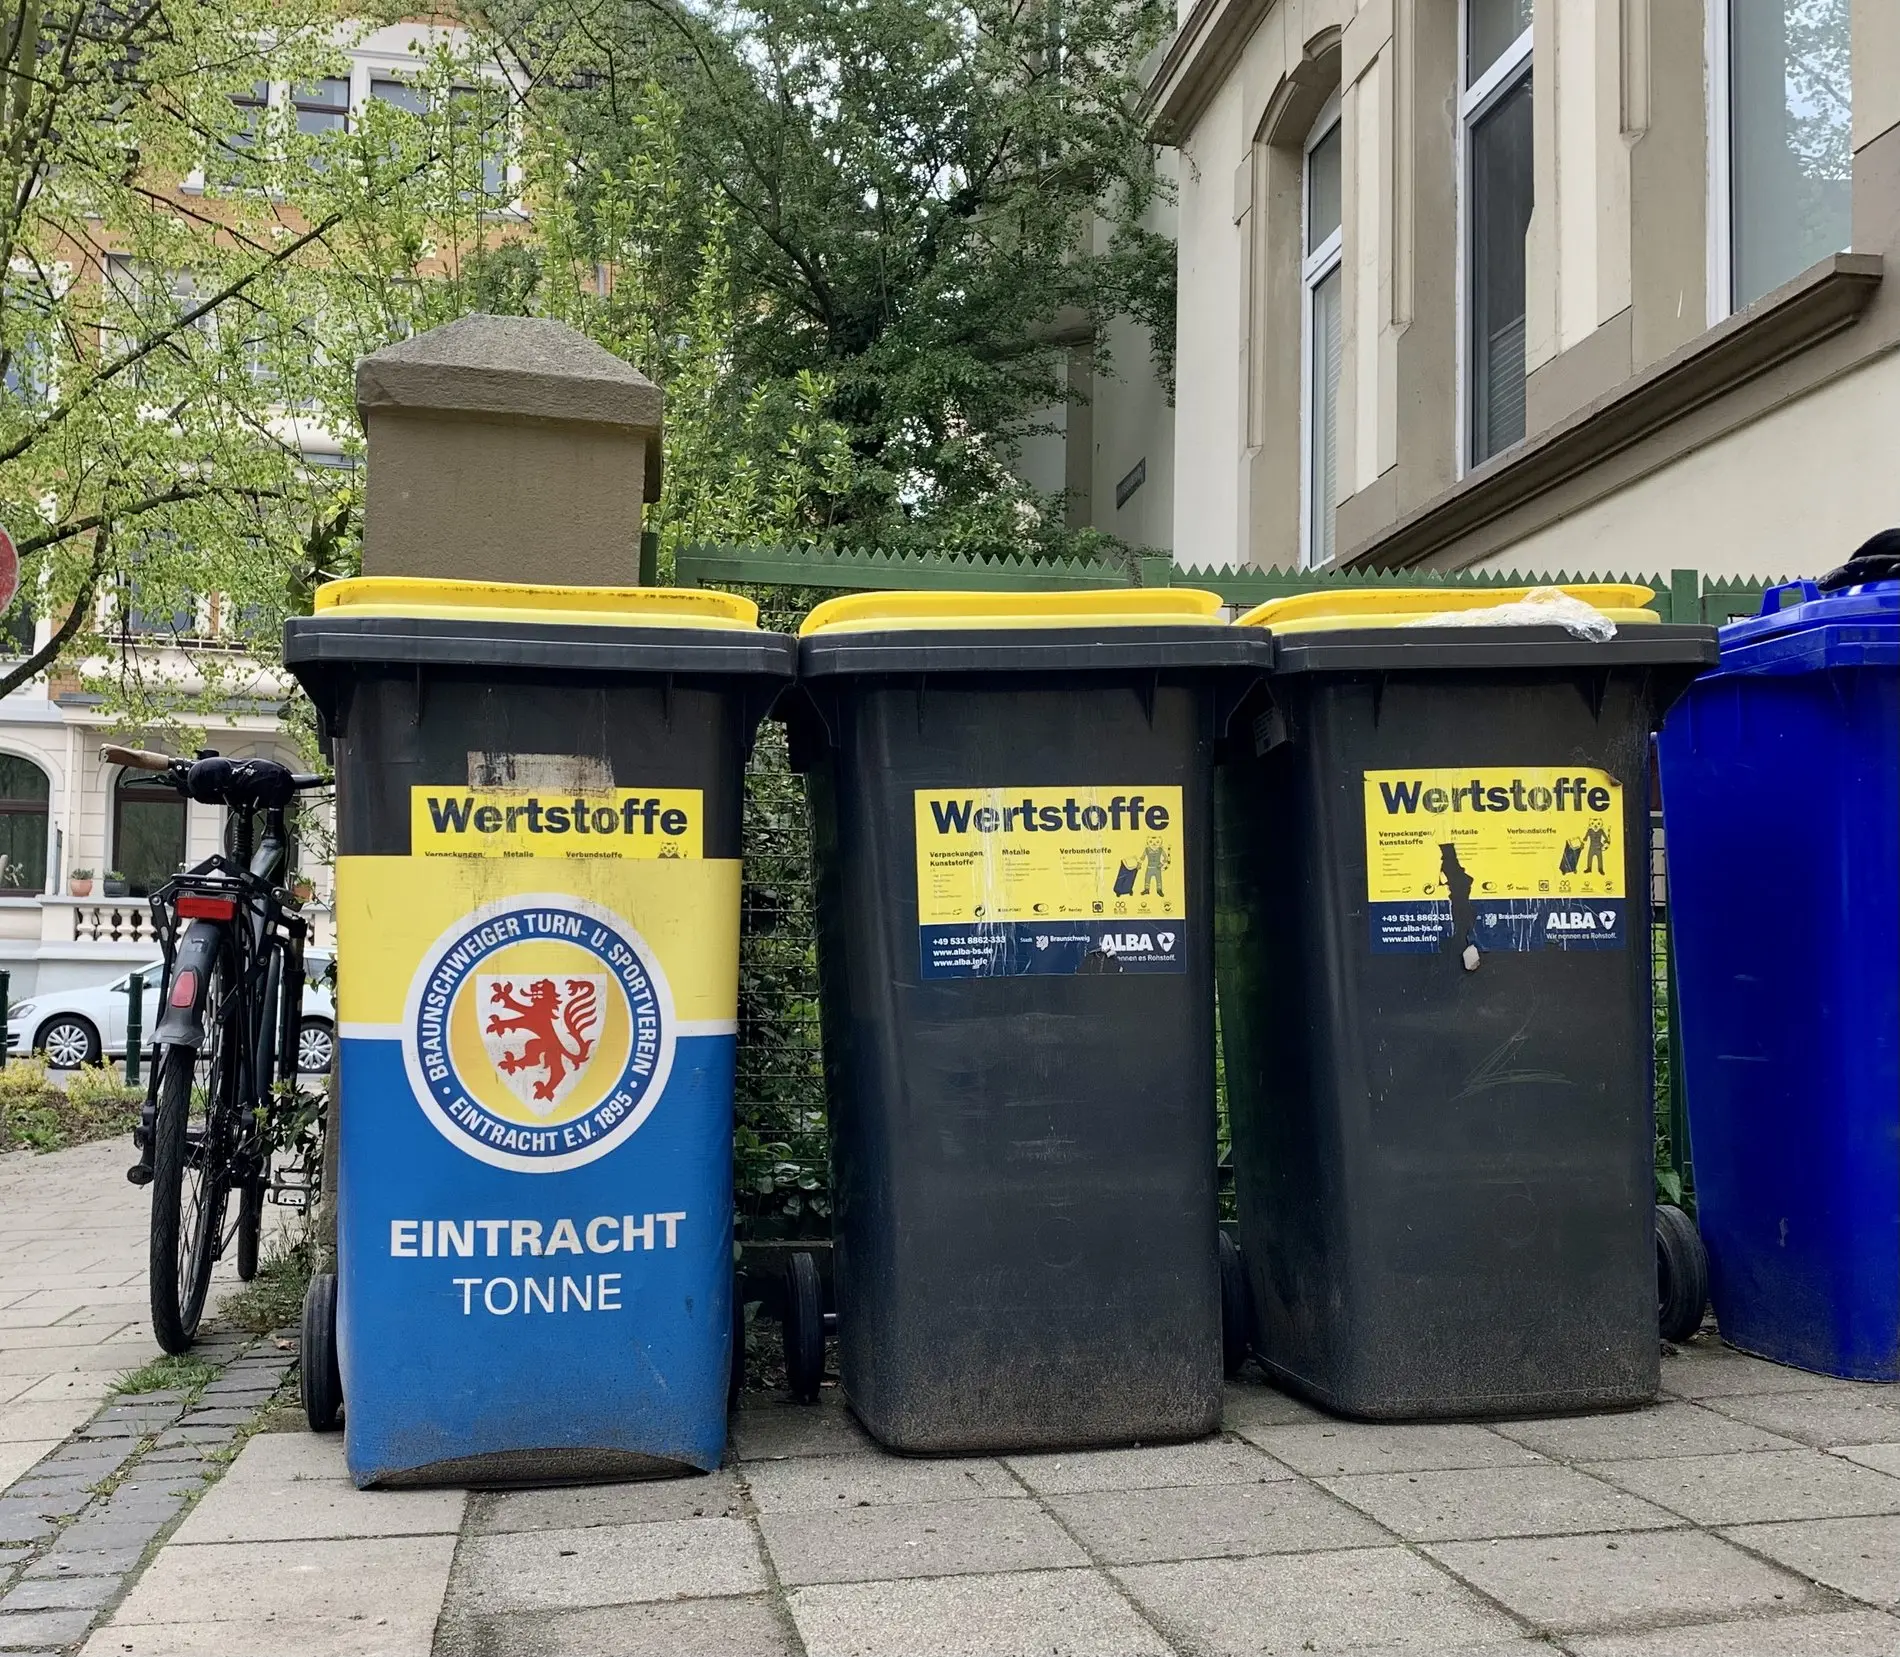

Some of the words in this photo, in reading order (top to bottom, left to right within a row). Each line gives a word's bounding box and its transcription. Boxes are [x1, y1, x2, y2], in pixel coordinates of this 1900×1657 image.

[1379, 777, 1611, 815] Wertstoffe
[427, 797, 688, 836] Wertstoffe
[930, 796, 1170, 834] Wertstoffe
[566, 851, 623, 859] Verbundstoffe
[1399, 914, 1415, 922] 531
[1498, 913, 1537, 921] Braunschweig
[1546, 912, 1597, 930] ALBA
[1381, 924, 1443, 933] www.alba-bs.de
[932, 938, 948, 946] +49
[967, 936, 1006, 945] 8862-333
[1050, 935, 1091, 943] Braunschweig
[1100, 933, 1154, 951] ALBA
[1382, 935, 1437, 943] www.alba.info
[932, 947, 993, 957] www.alba-bs.de
[933, 958, 988, 967] www.alba.info
[422, 917, 521, 1082] BRAUNSCHWEIGER
[523, 913, 588, 938] TURN-
[590, 927, 606, 952] U.
[608, 943, 657, 1076] SPORTVEREIN
[449, 1096, 559, 1152] EINTRACHT
[564, 1120, 597, 1148] E.V.
[594, 1090, 633, 1133] 1895
[390, 1211, 687, 1258] EINTRACHT
[452, 1273, 622, 1315] TONNE
